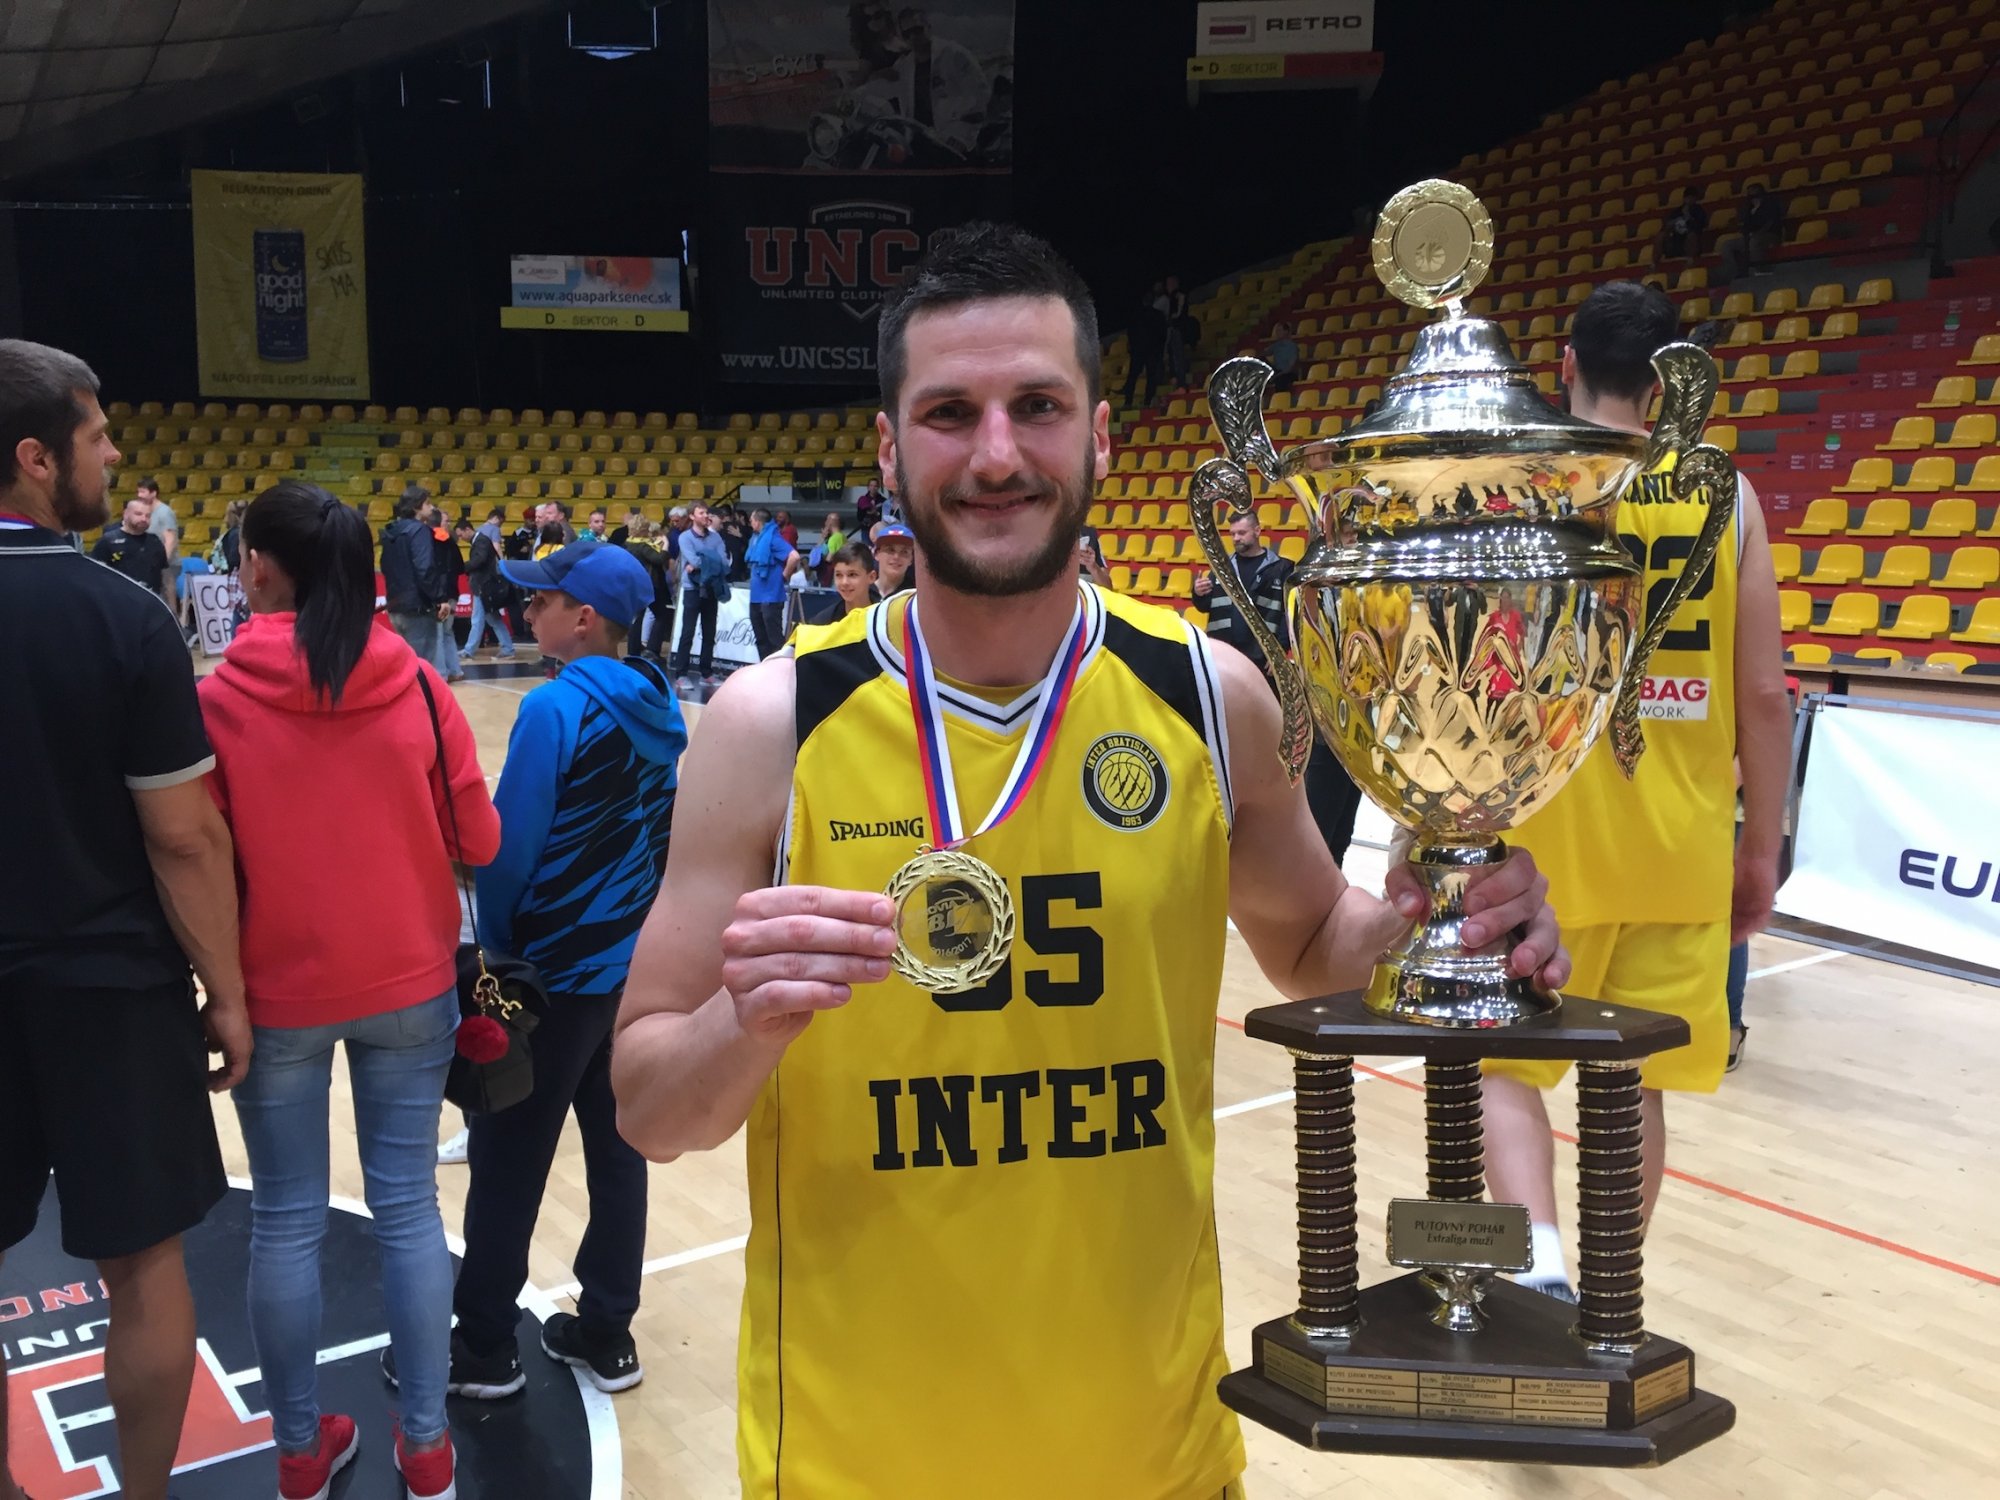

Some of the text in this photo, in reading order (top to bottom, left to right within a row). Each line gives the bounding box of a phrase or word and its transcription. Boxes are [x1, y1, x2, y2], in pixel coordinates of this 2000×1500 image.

[1266, 15, 1362, 31] RETRO
[1208, 62, 1278, 74] D SEKTOR
[745, 226, 945, 287] UNC
[257, 269, 303, 291] good
[258, 289, 304, 313] night
[519, 290, 672, 304] www.aquaparksenec.sk
[760, 289, 835, 299] UNLIMITED
[545, 312, 645, 327] D SEKTOR D
[825, 479, 842, 489] WC
[1640, 678, 1707, 702] BAG
[1640, 705, 1686, 718] WORK
[1086, 736, 1159, 770] INTER BRATISLAVA
[1121, 815, 1142, 826] 1963
[829, 817, 924, 842] SPALDING
[1899, 848, 2000, 904] EU
[868, 1058, 1167, 1170] INTER
[1426, 1232, 1467, 1246] Extraliga
